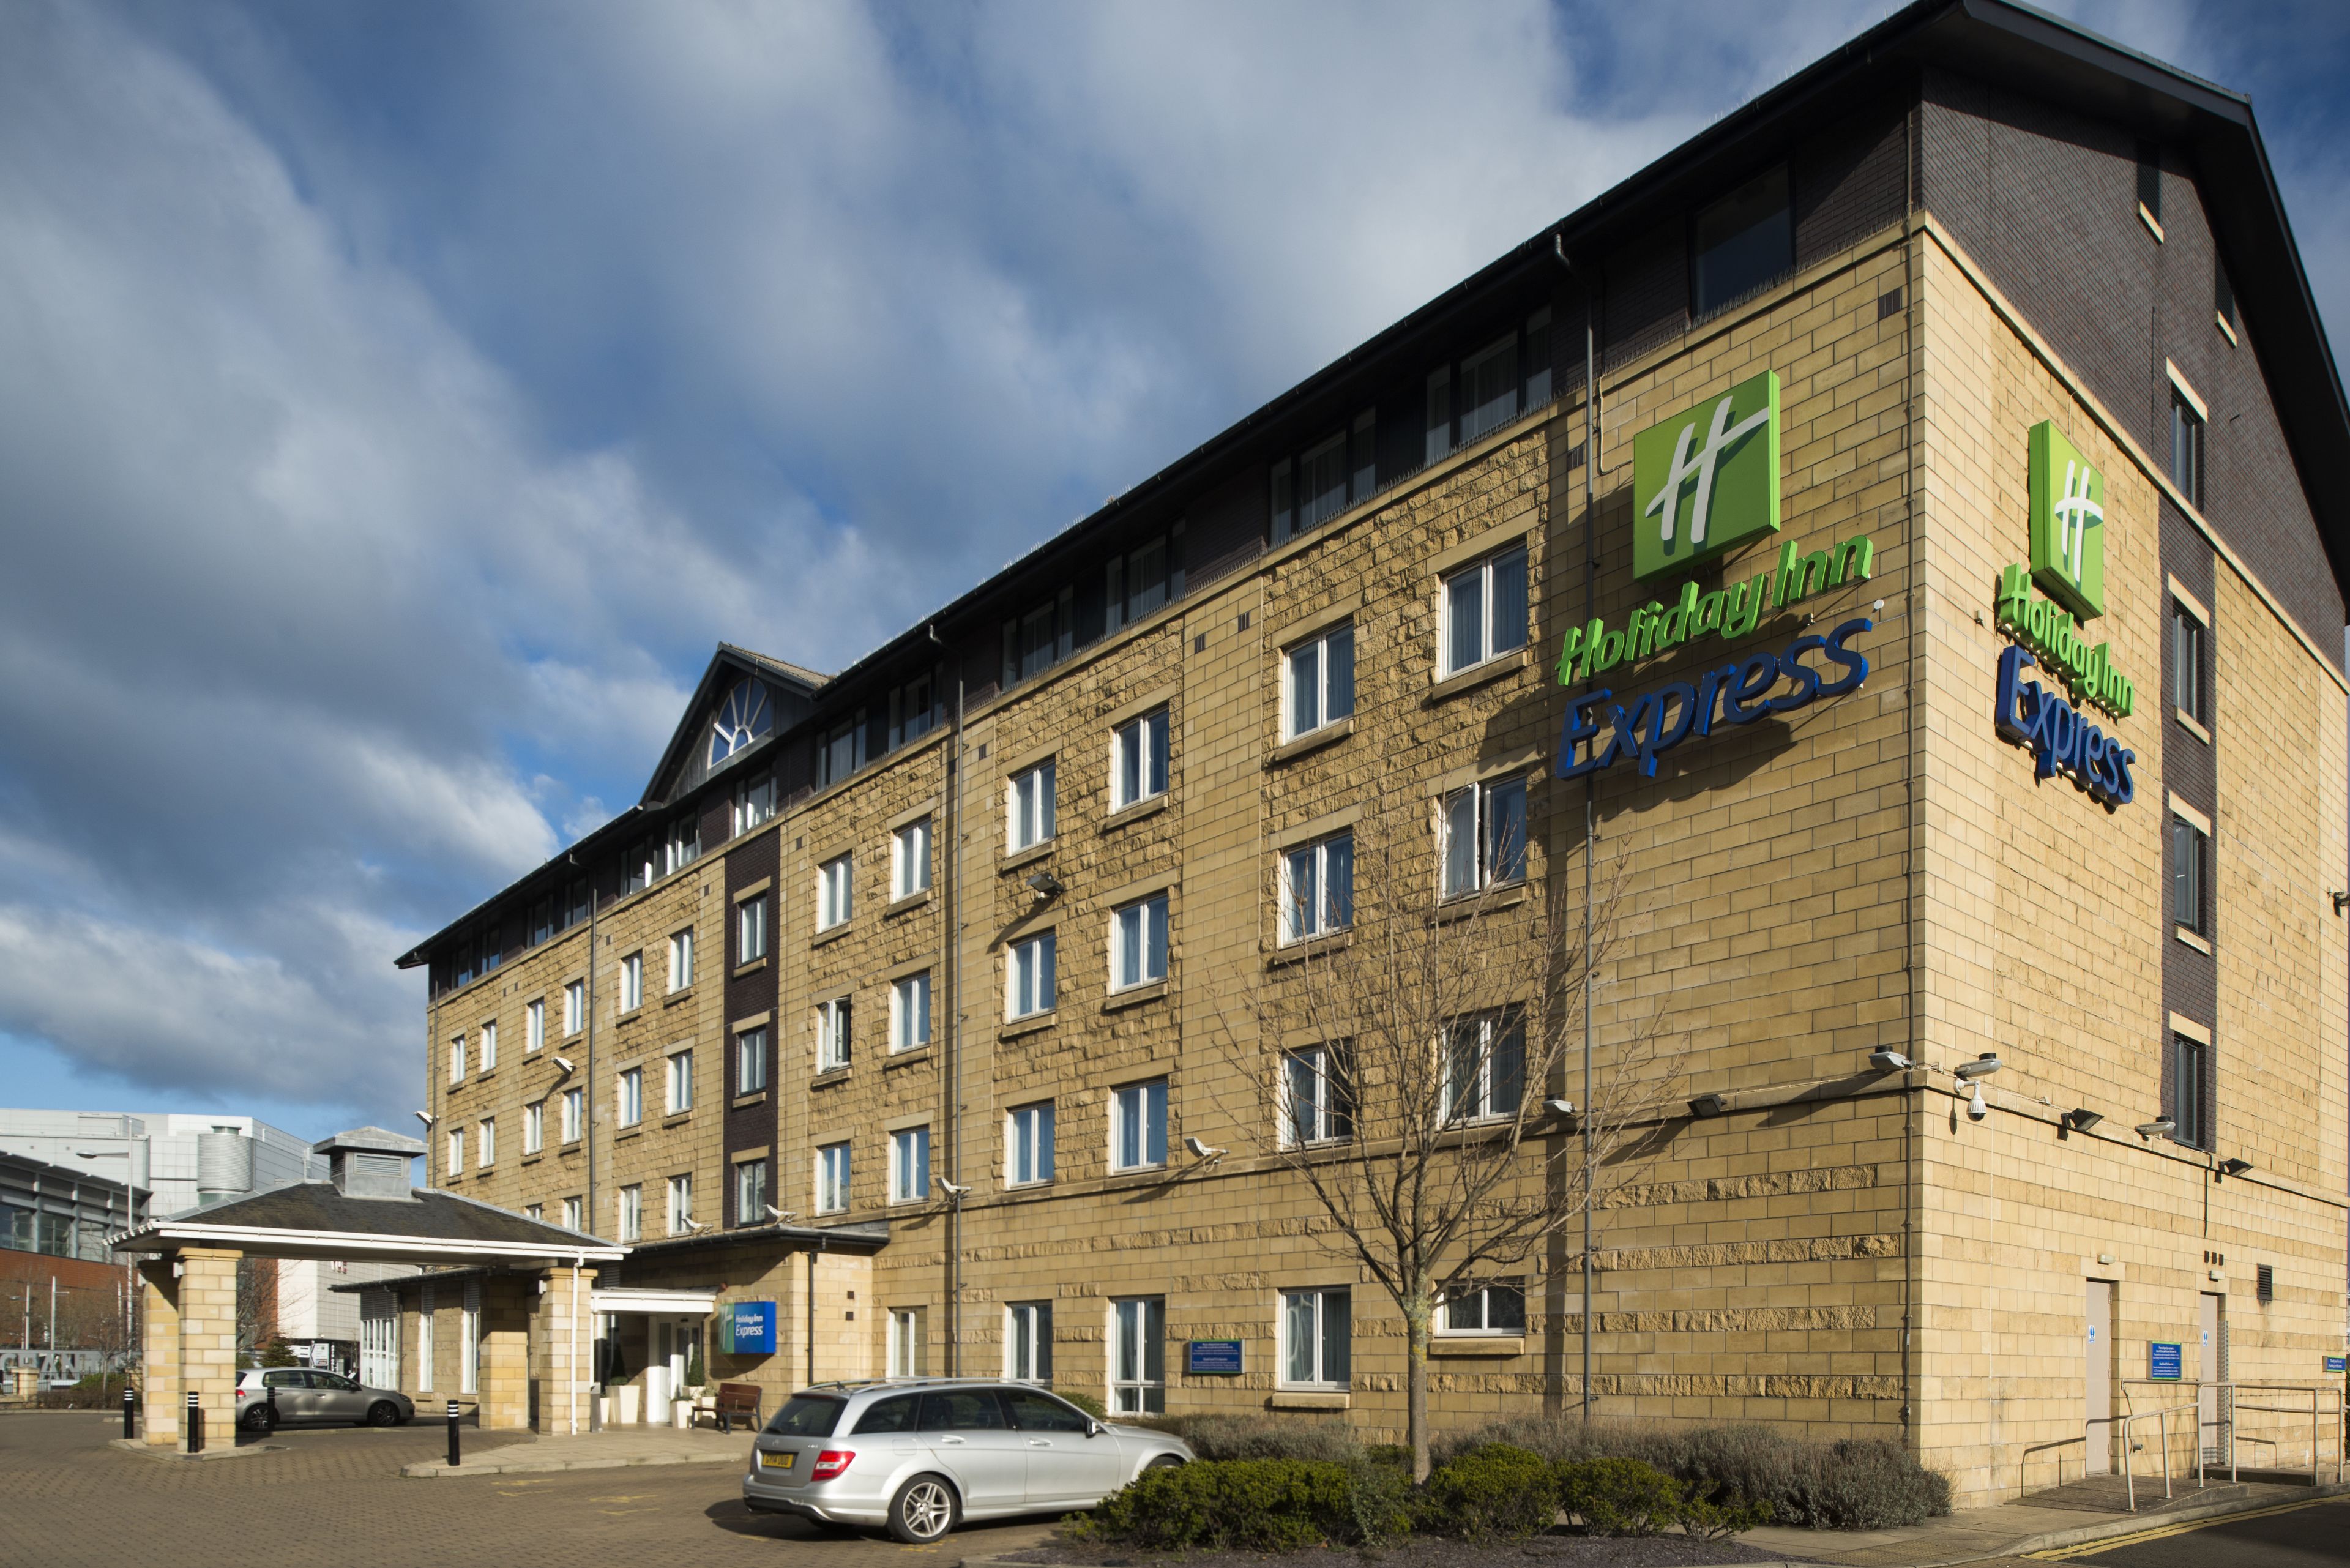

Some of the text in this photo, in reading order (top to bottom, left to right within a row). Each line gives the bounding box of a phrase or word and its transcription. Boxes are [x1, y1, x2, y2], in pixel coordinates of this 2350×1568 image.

[1555, 534, 1874, 687] Holiday Inn
[1999, 562, 2134, 718] Holiday Inn
[1555, 618, 1874, 780] Express
[1996, 643, 2136, 805] Express
[736, 1313, 764, 1324] Holiday Inn
[736, 1324, 764, 1338] Express
